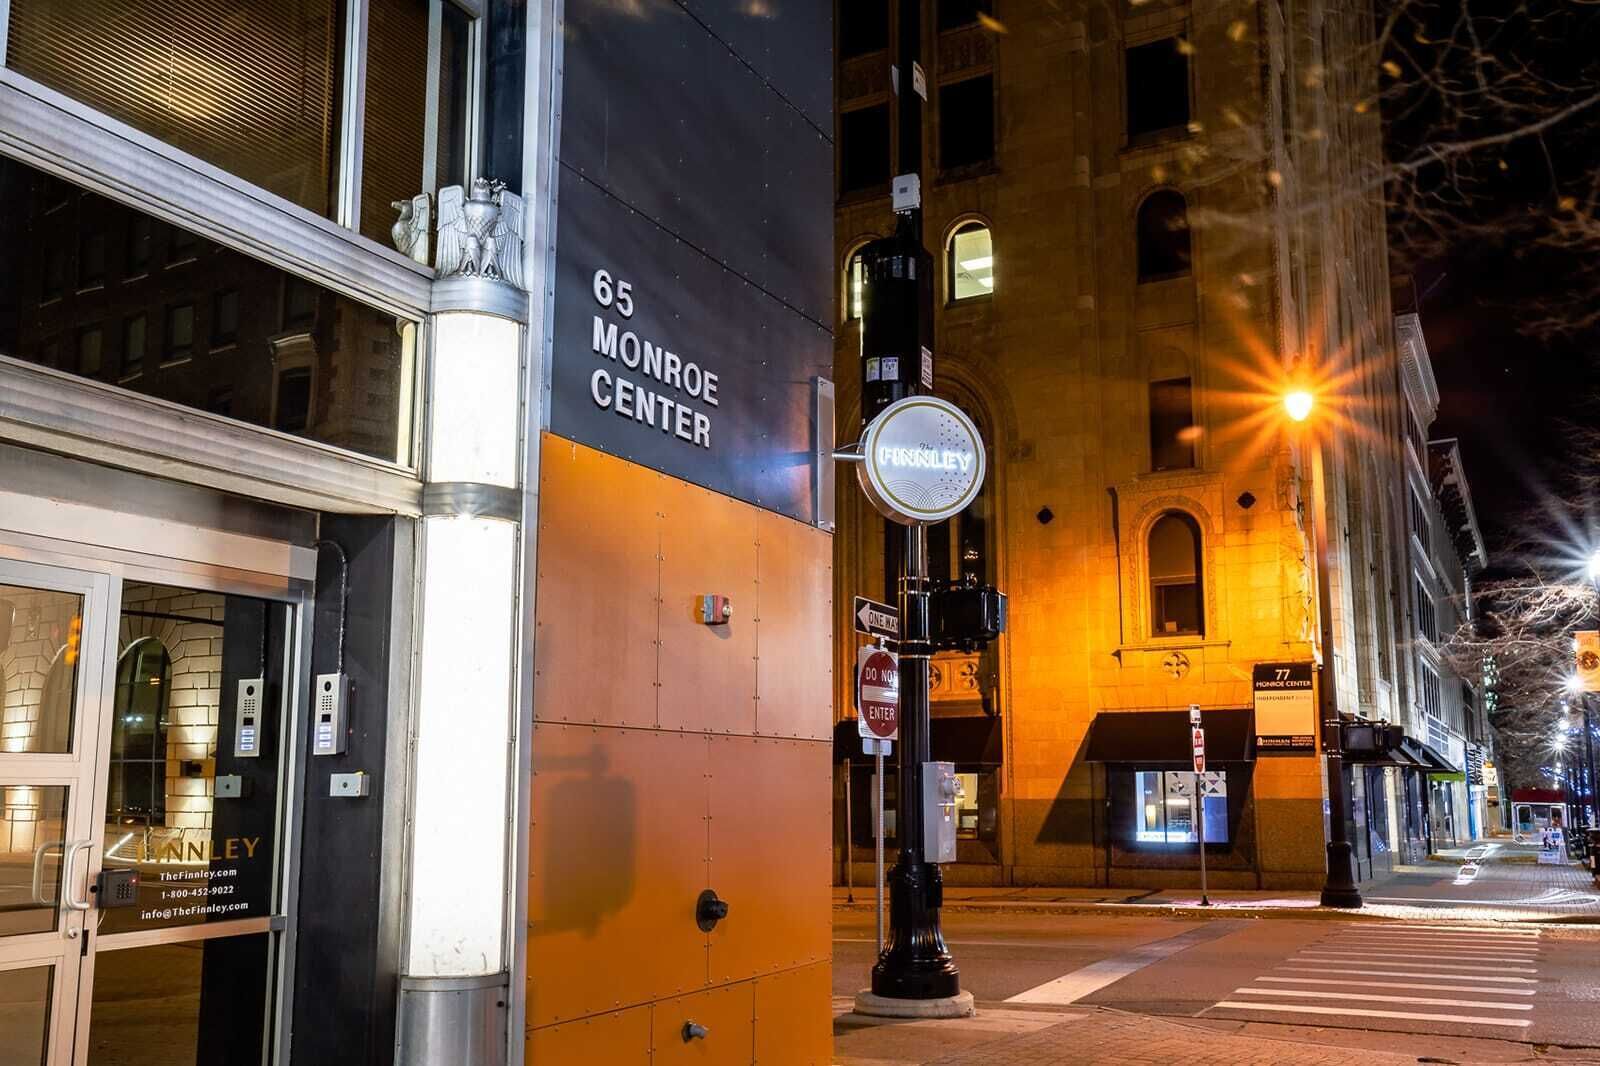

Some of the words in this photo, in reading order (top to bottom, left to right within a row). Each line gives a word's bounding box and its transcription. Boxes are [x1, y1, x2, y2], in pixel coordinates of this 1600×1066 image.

[592, 269, 635, 318] 65
[592, 315, 720, 407] MONROE
[590, 369, 711, 449] CENTER
[879, 447, 972, 471] FINNLEY
[868, 611, 885, 628] ONE
[865, 667, 877, 681] DO
[1275, 669, 1290, 681] 77
[869, 705, 895, 721] ENTER
[160, 868, 237, 881] TheFinnley.com
[161, 885, 234, 899] 1-800-452-9022
[141, 902, 249, 919] info@TheFinnley.com
